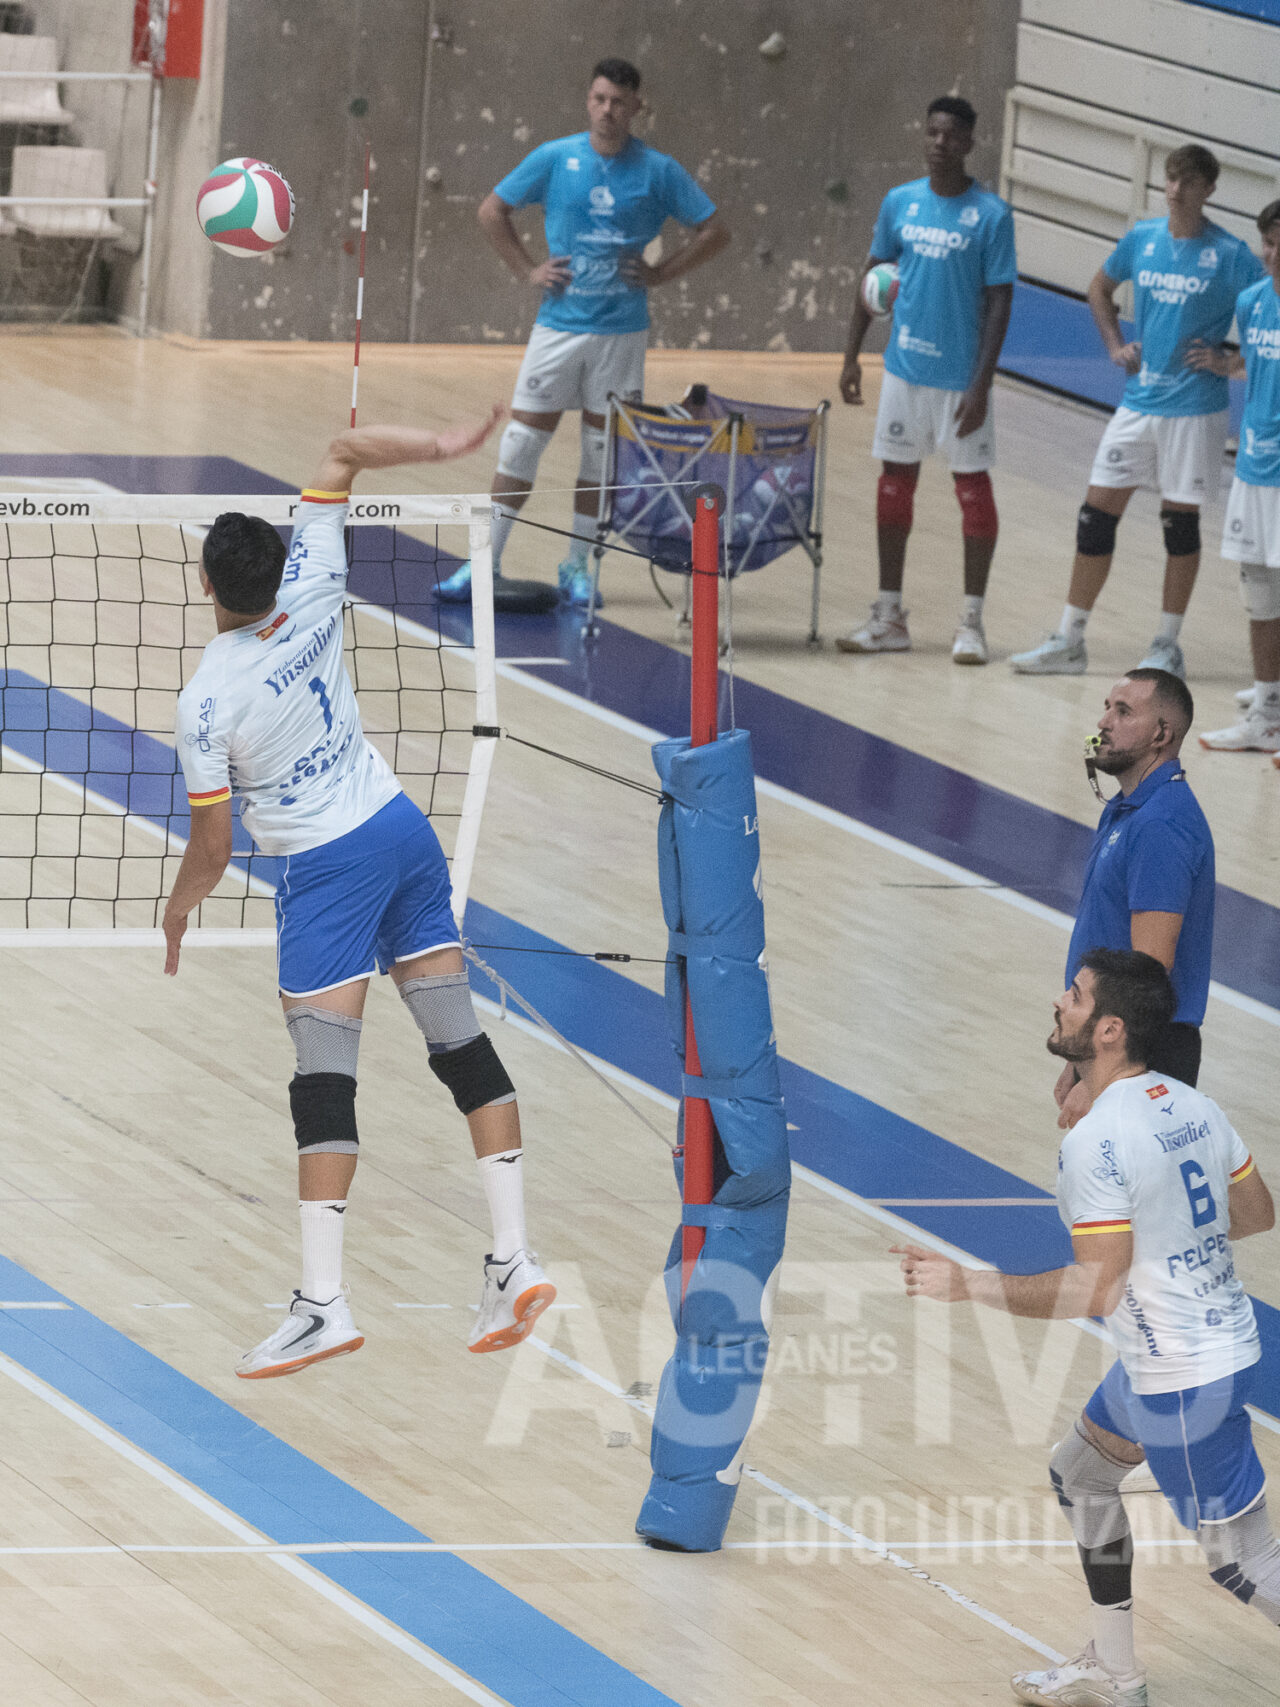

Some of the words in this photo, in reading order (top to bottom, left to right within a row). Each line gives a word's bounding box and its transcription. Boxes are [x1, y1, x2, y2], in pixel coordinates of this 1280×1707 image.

[288, 503, 401, 518] r.com
[308, 675, 333, 735] 1
[1179, 1159, 1217, 1229] 6
